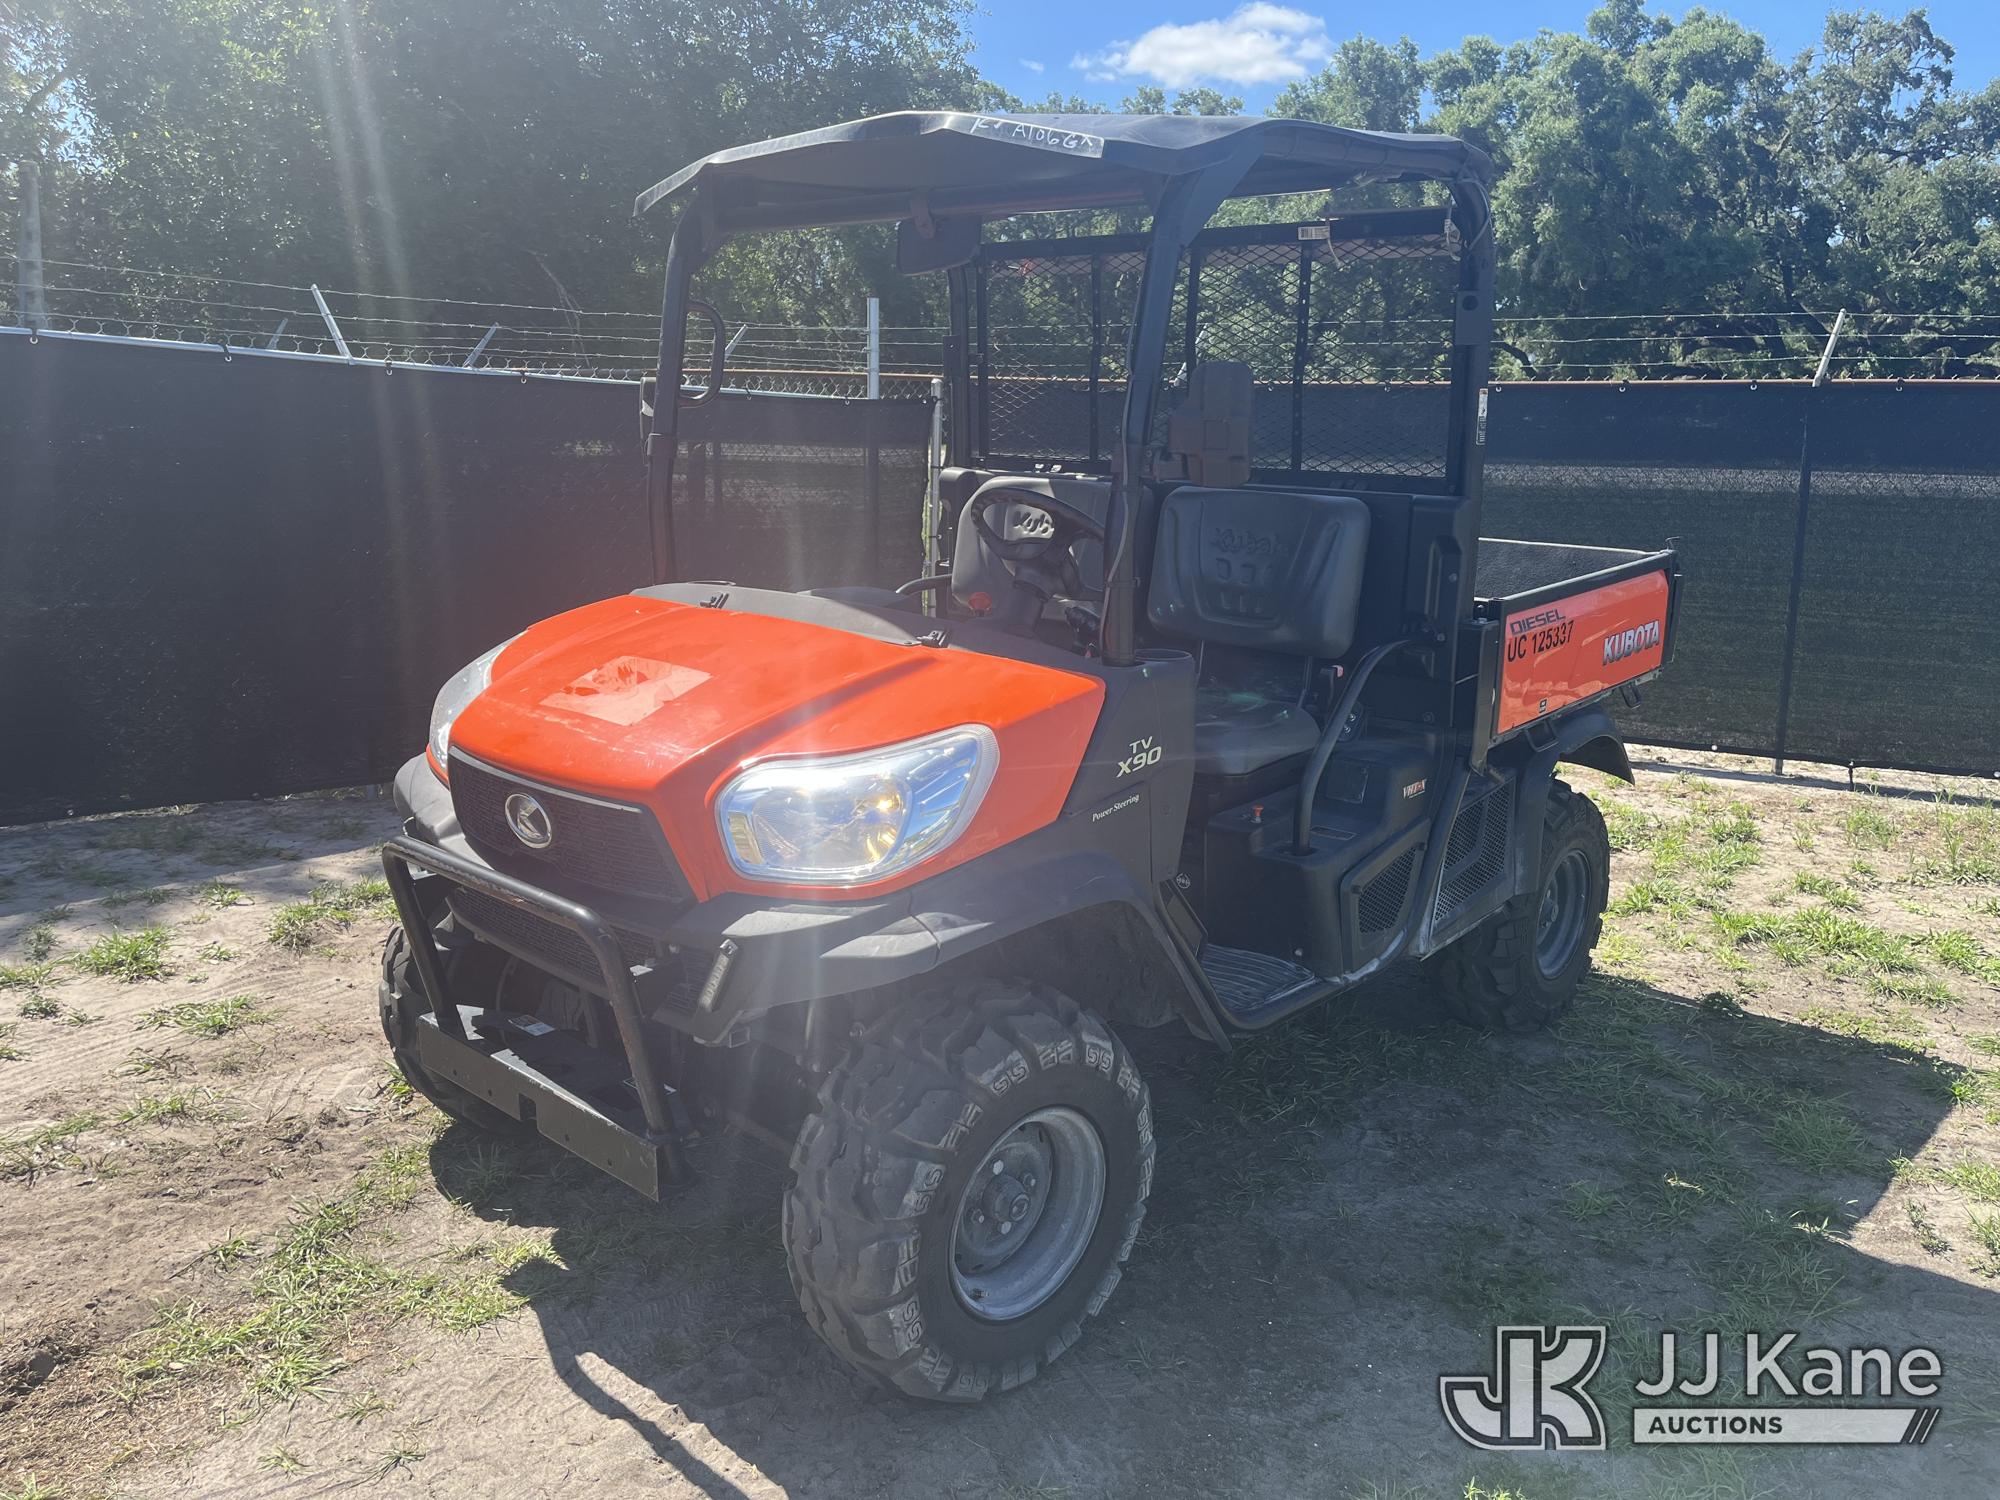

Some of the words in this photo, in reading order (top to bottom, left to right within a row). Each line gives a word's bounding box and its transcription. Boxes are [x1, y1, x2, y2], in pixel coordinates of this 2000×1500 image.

[1510, 608, 1566, 635] DIESEL
[1507, 634, 1528, 662] UC
[1531, 620, 1575, 654] 125337
[1602, 620, 1660, 666] KUBOTA
[1129, 736, 1153, 754] TV
[1116, 746, 1162, 778] X90
[1092, 807, 1113, 822] Power
[1113, 794, 1140, 812] Steering
